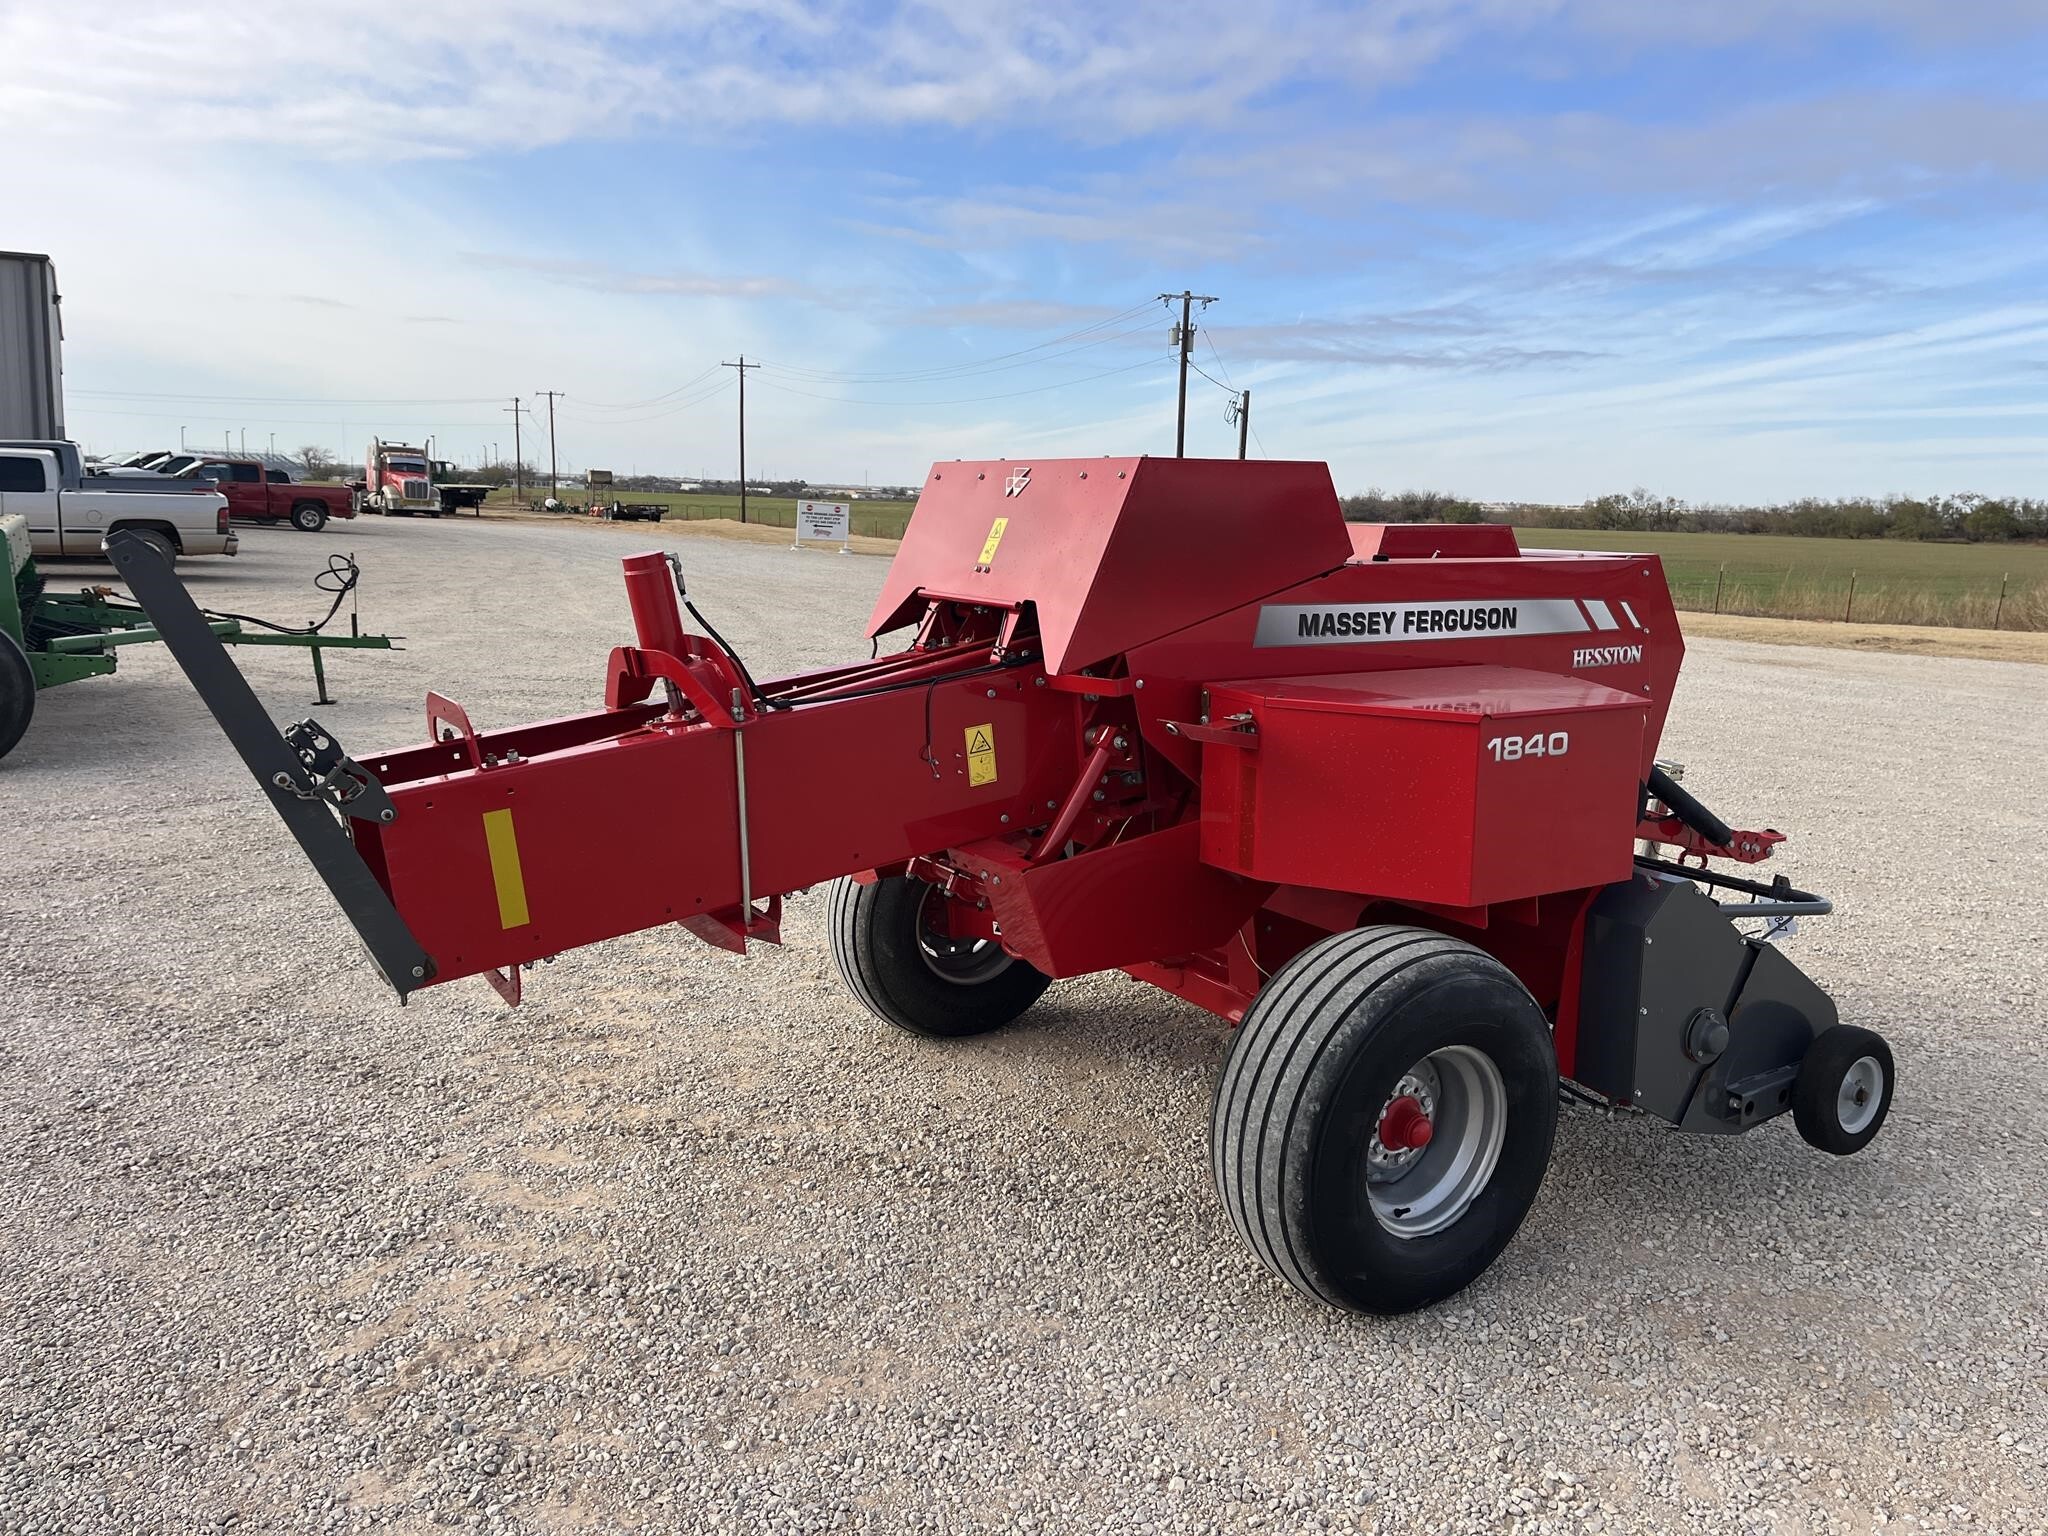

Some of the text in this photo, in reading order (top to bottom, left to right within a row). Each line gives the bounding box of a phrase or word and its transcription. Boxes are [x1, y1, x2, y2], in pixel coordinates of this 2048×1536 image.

[1298, 607, 1518, 638] MASSEY FERGUSON
[1572, 644, 1643, 669] HESSTON
[1487, 731, 1569, 762] 1840
